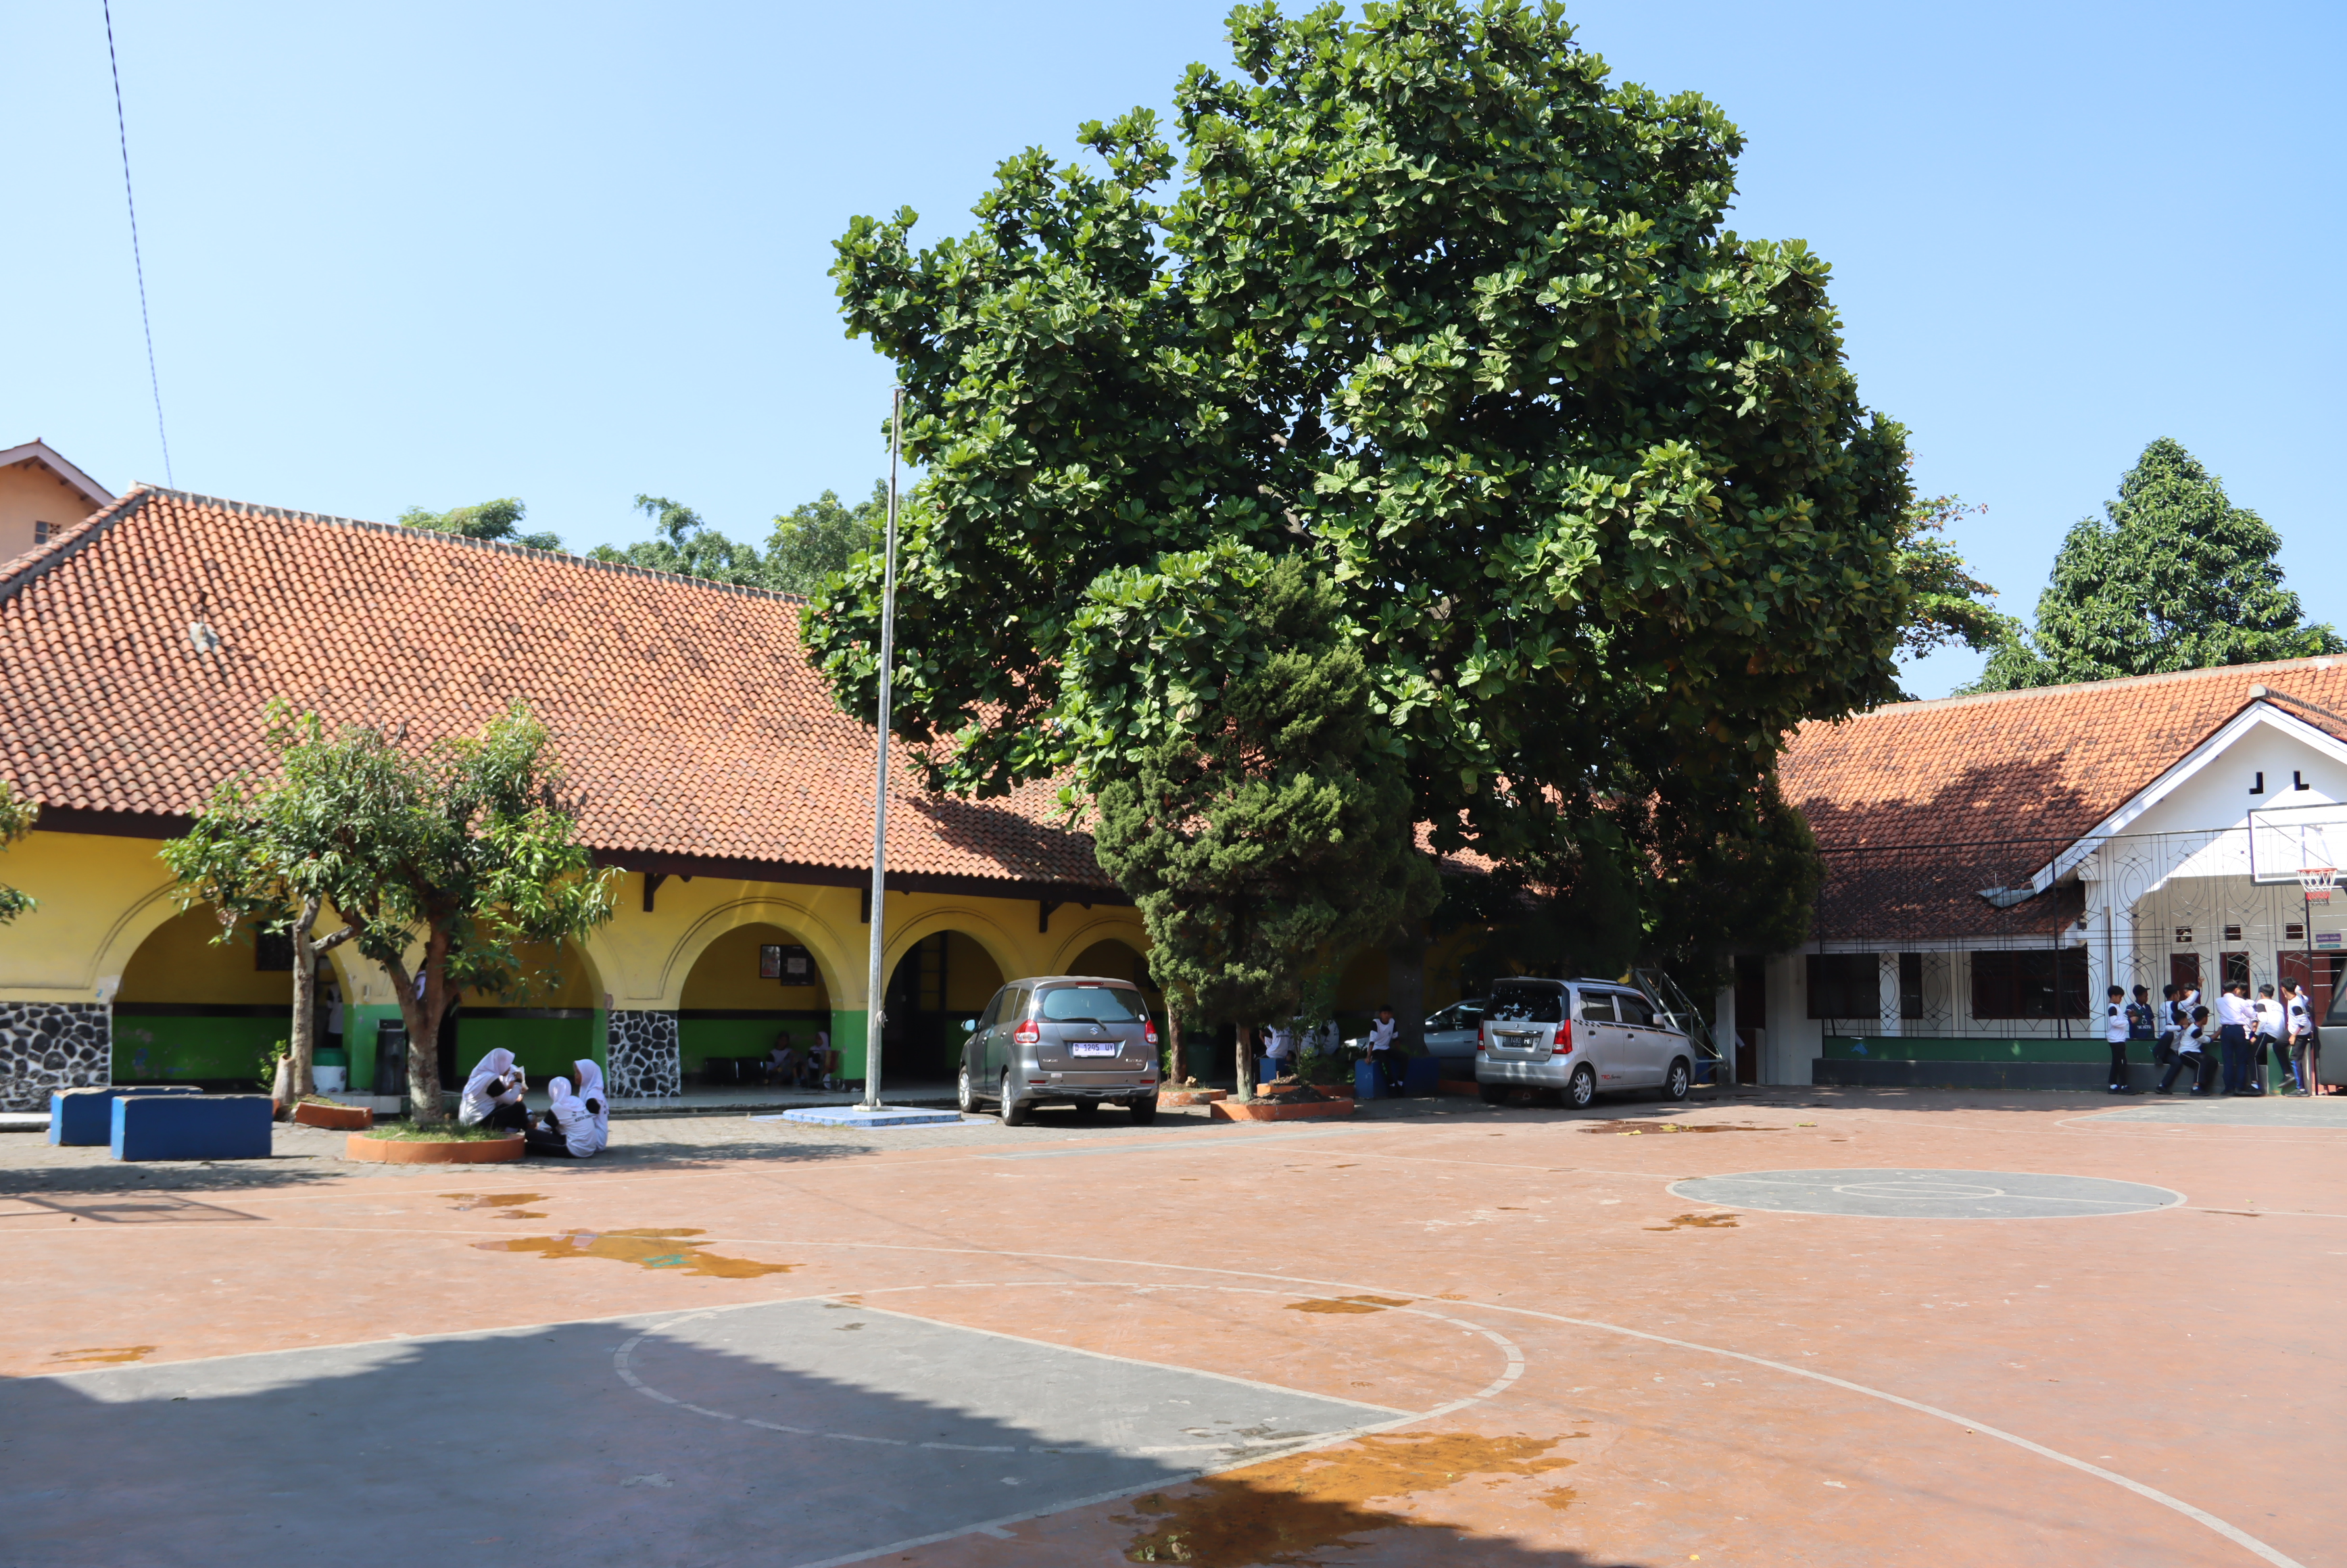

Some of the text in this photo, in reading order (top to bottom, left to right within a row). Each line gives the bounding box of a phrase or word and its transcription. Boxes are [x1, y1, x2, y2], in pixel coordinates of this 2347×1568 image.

[1075, 1044, 1113, 1052] D 1295 UY
